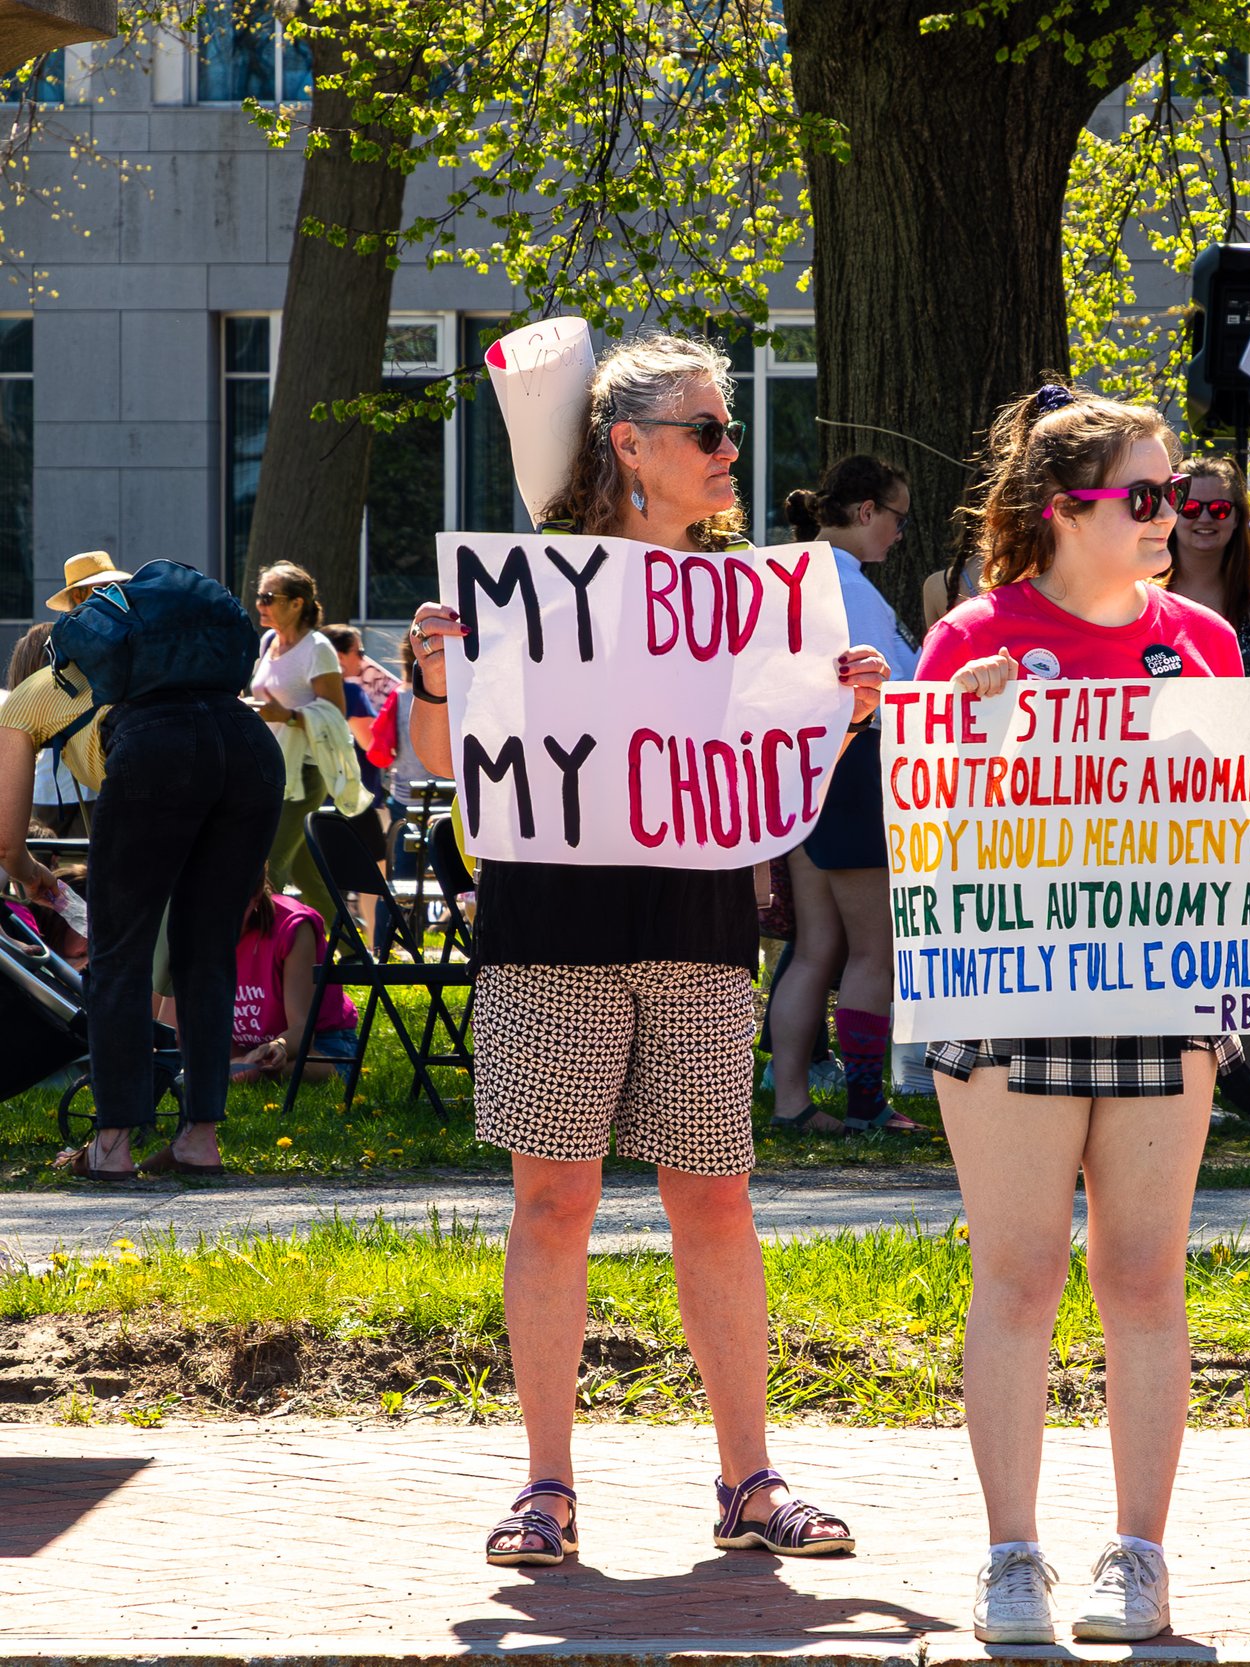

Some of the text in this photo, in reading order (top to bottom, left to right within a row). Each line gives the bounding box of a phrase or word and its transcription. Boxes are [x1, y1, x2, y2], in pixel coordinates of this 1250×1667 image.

[456, 543, 810, 663] MY BODY
[1145, 651, 1166, 664] BANS
[1148, 655, 1182, 669] OFF OUR
[1151, 662, 1182, 676] BODIES
[884, 685, 1151, 744] THE STATE
[462, 732, 597, 848] MY
[890, 755, 1128, 810] CONTROLLING
[1137, 758, 1160, 804] A
[888, 819, 969, 874] BODY
[976, 817, 1073, 870] WOULD
[1083, 818, 1158, 867] MEAN
[893, 885, 942, 938] HER
[952, 884, 1034, 934] FULL
[1046, 881, 1232, 930] AUTONOMY
[899, 945, 1057, 1001] ULTIMATELY
[1069, 942, 1134, 993] FULL
